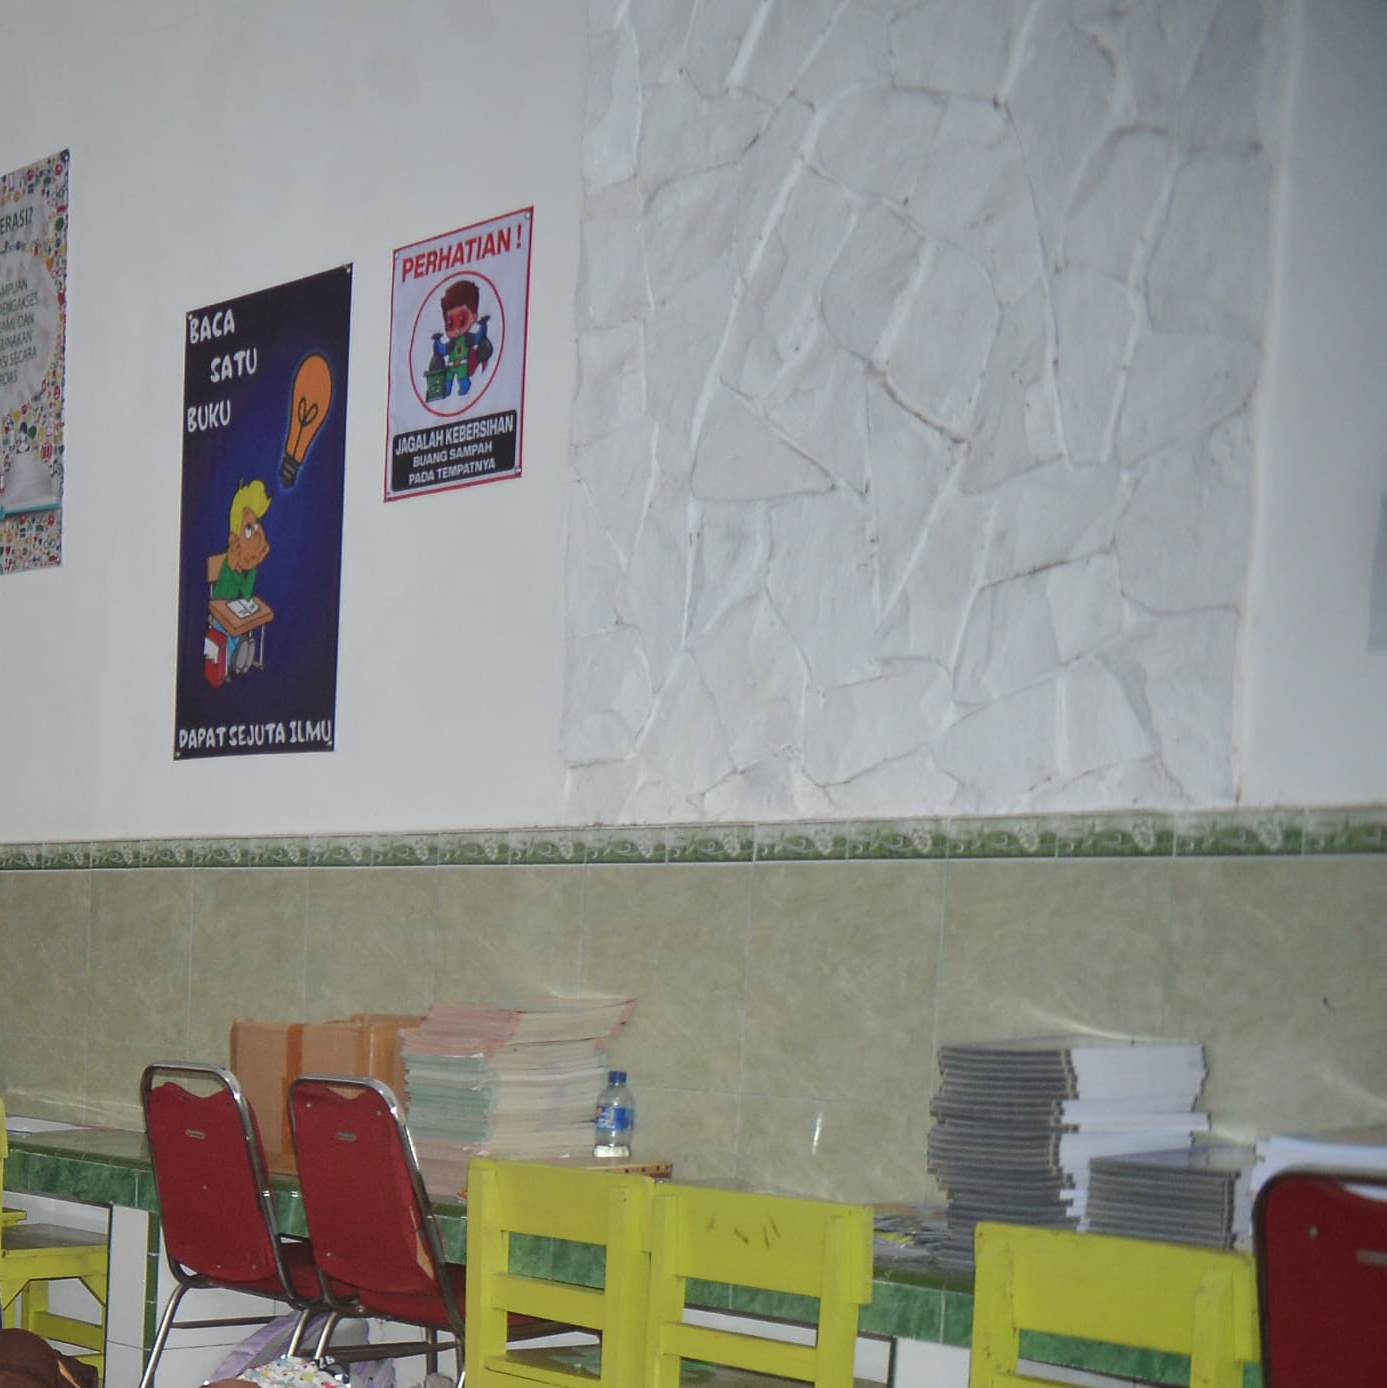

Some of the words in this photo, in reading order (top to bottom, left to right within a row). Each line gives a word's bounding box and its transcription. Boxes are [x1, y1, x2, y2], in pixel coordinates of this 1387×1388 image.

[402, 227, 511, 282] PERHATIAN
[189, 309, 235, 344] BACA
[210, 347, 257, 383] SATU
[187, 399, 231, 432] BUKU
[396, 430, 443, 455] JAGALAH
[445, 414, 514, 446] KEBERSIHAN
[413, 450, 447, 468] BUANG
[449, 441, 493, 460] SAMPAH
[408, 469, 435, 486] PADA
[437, 458, 496, 480] TEMPATNYA
[178, 726, 226, 748] DAPAT
[228, 722, 286, 746] SEJUTA
[289, 719, 331, 743] ILMU
